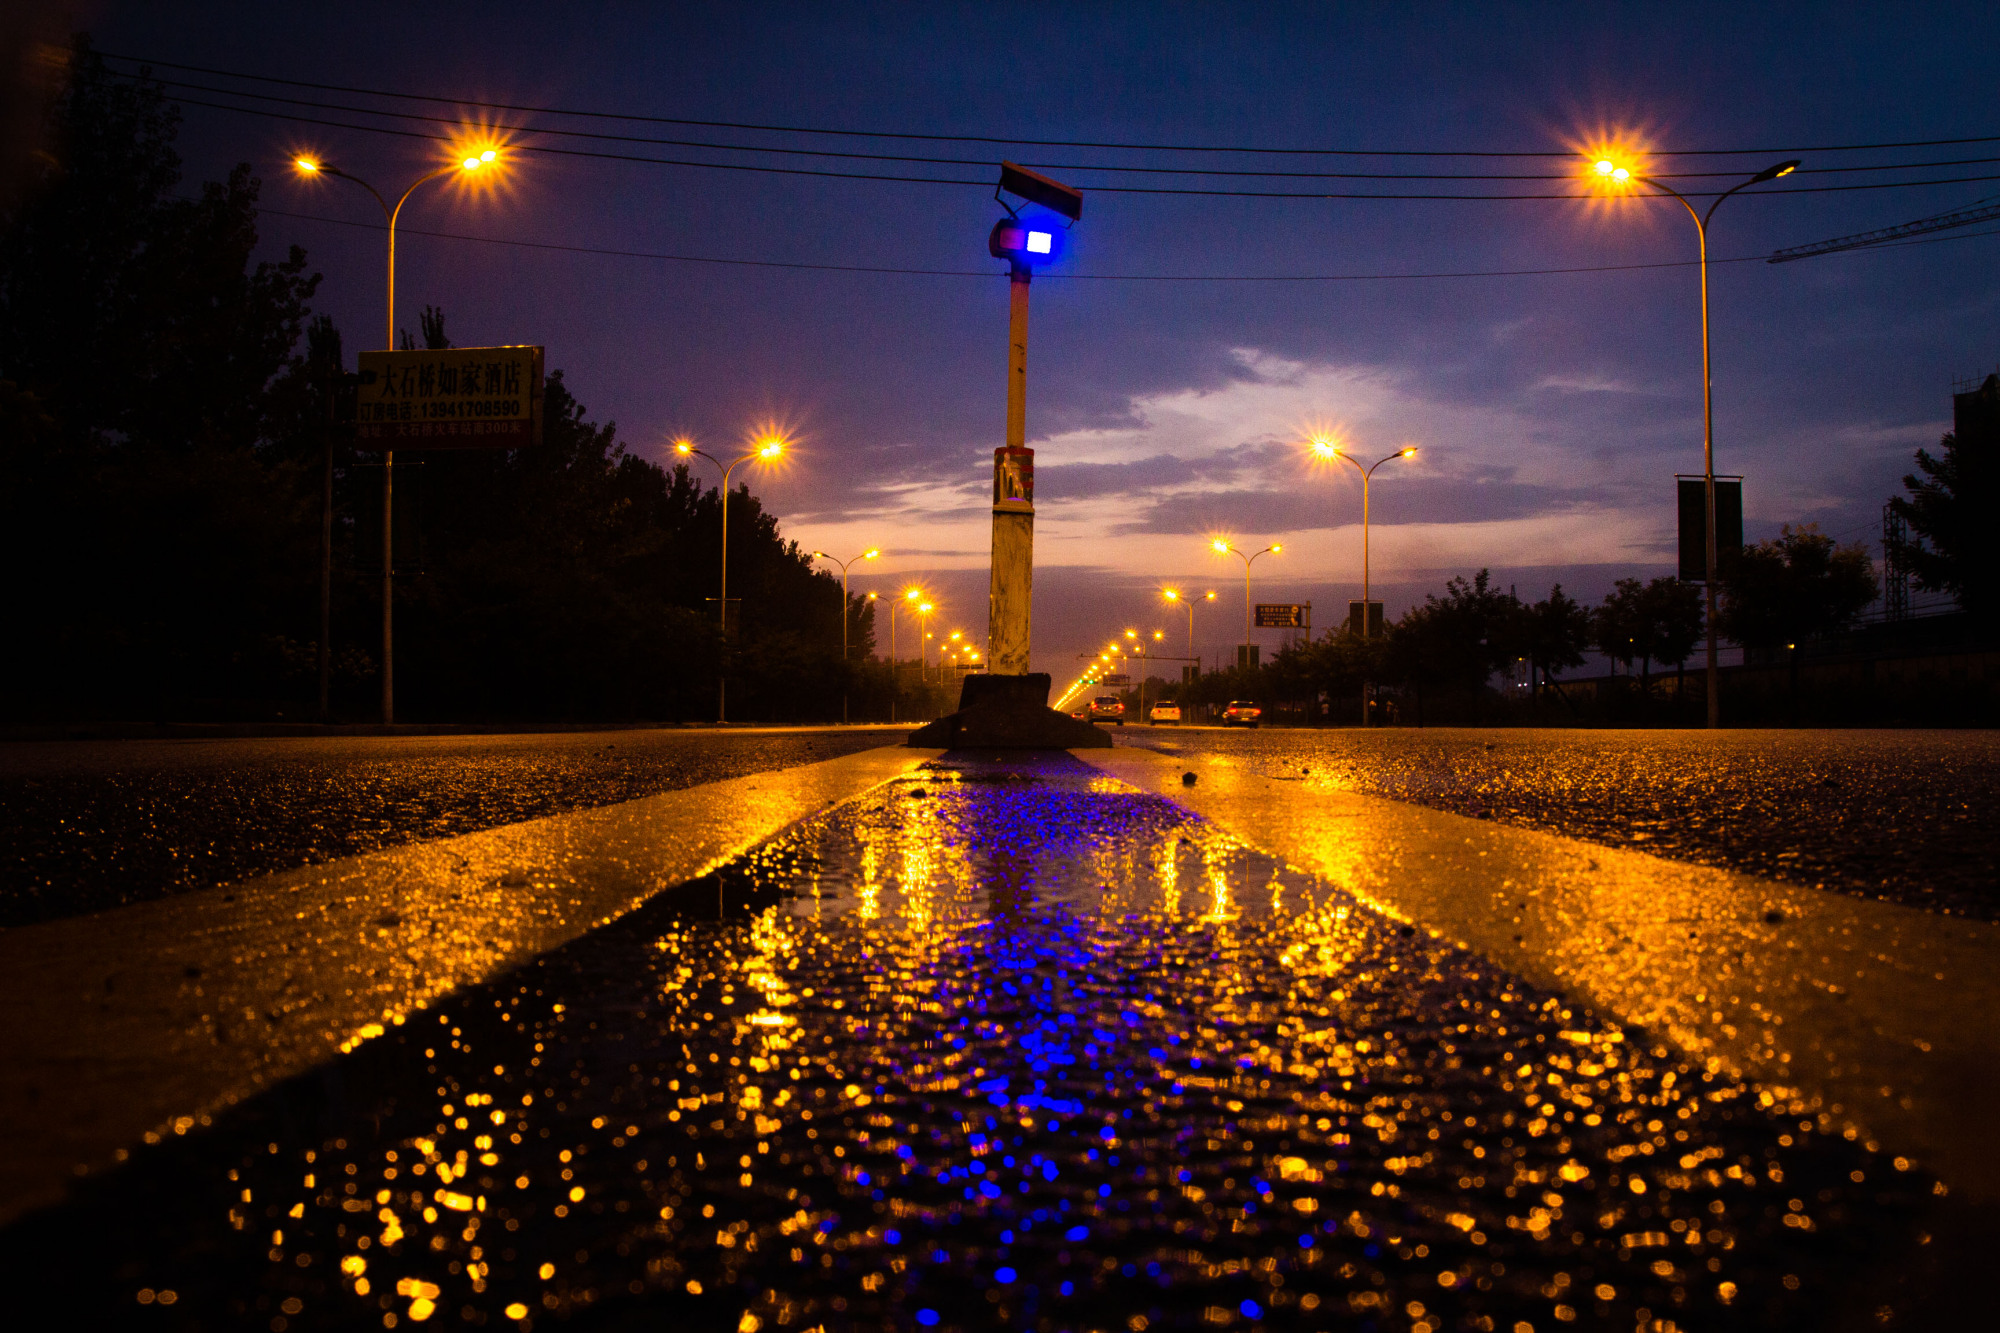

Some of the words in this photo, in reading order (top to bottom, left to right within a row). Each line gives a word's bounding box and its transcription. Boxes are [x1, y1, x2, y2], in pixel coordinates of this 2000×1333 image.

[381, 360, 521, 398] 大石桥如家酒店
